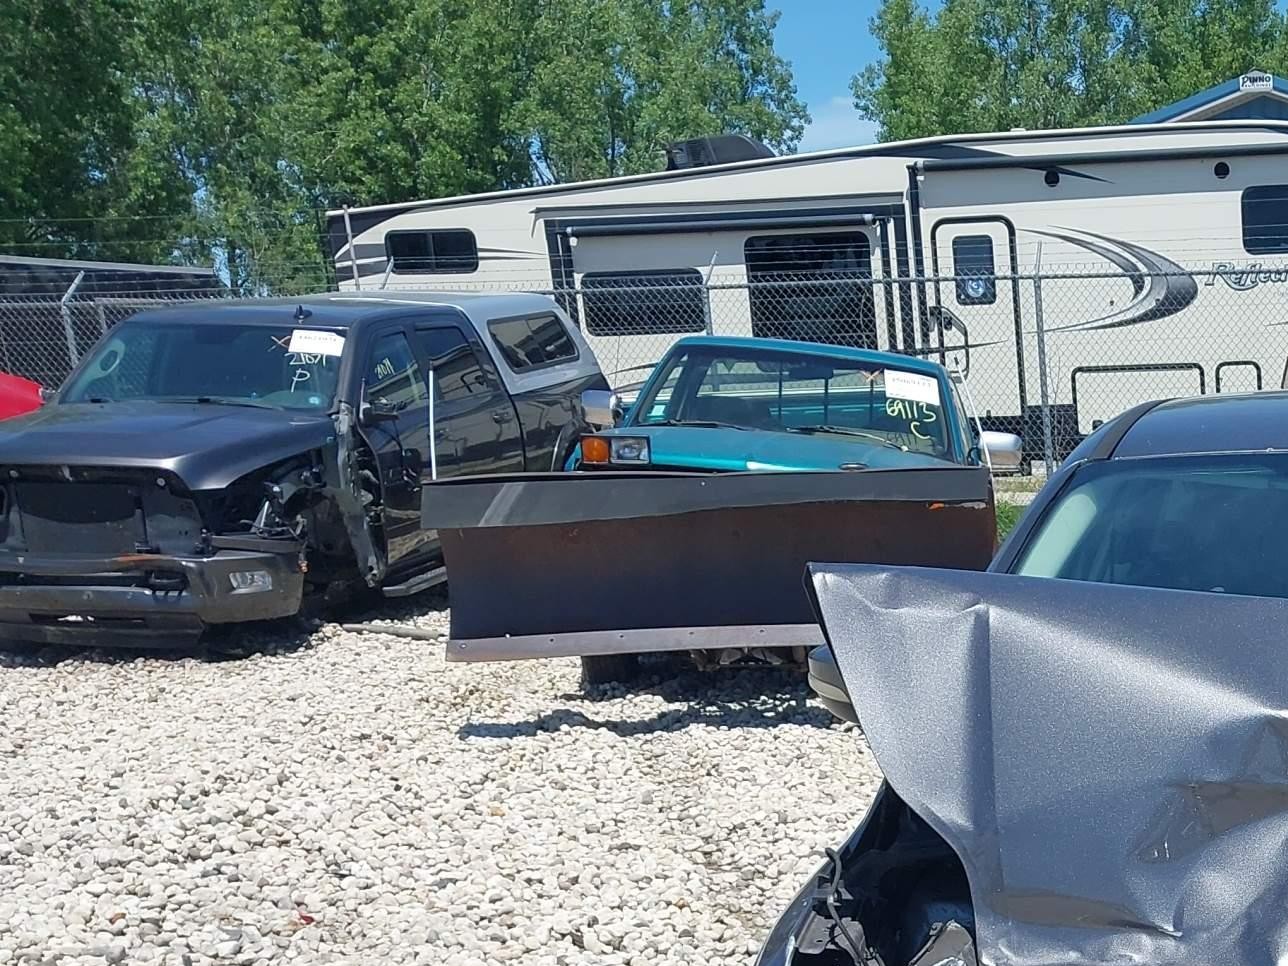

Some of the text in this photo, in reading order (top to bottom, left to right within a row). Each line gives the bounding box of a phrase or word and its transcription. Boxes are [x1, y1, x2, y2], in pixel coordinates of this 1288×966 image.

[1241, 75, 1271, 87] PINNO
[291, 367, 311, 393] P
[886, 399, 937, 422] 69113
[910, 421, 931, 439] C
